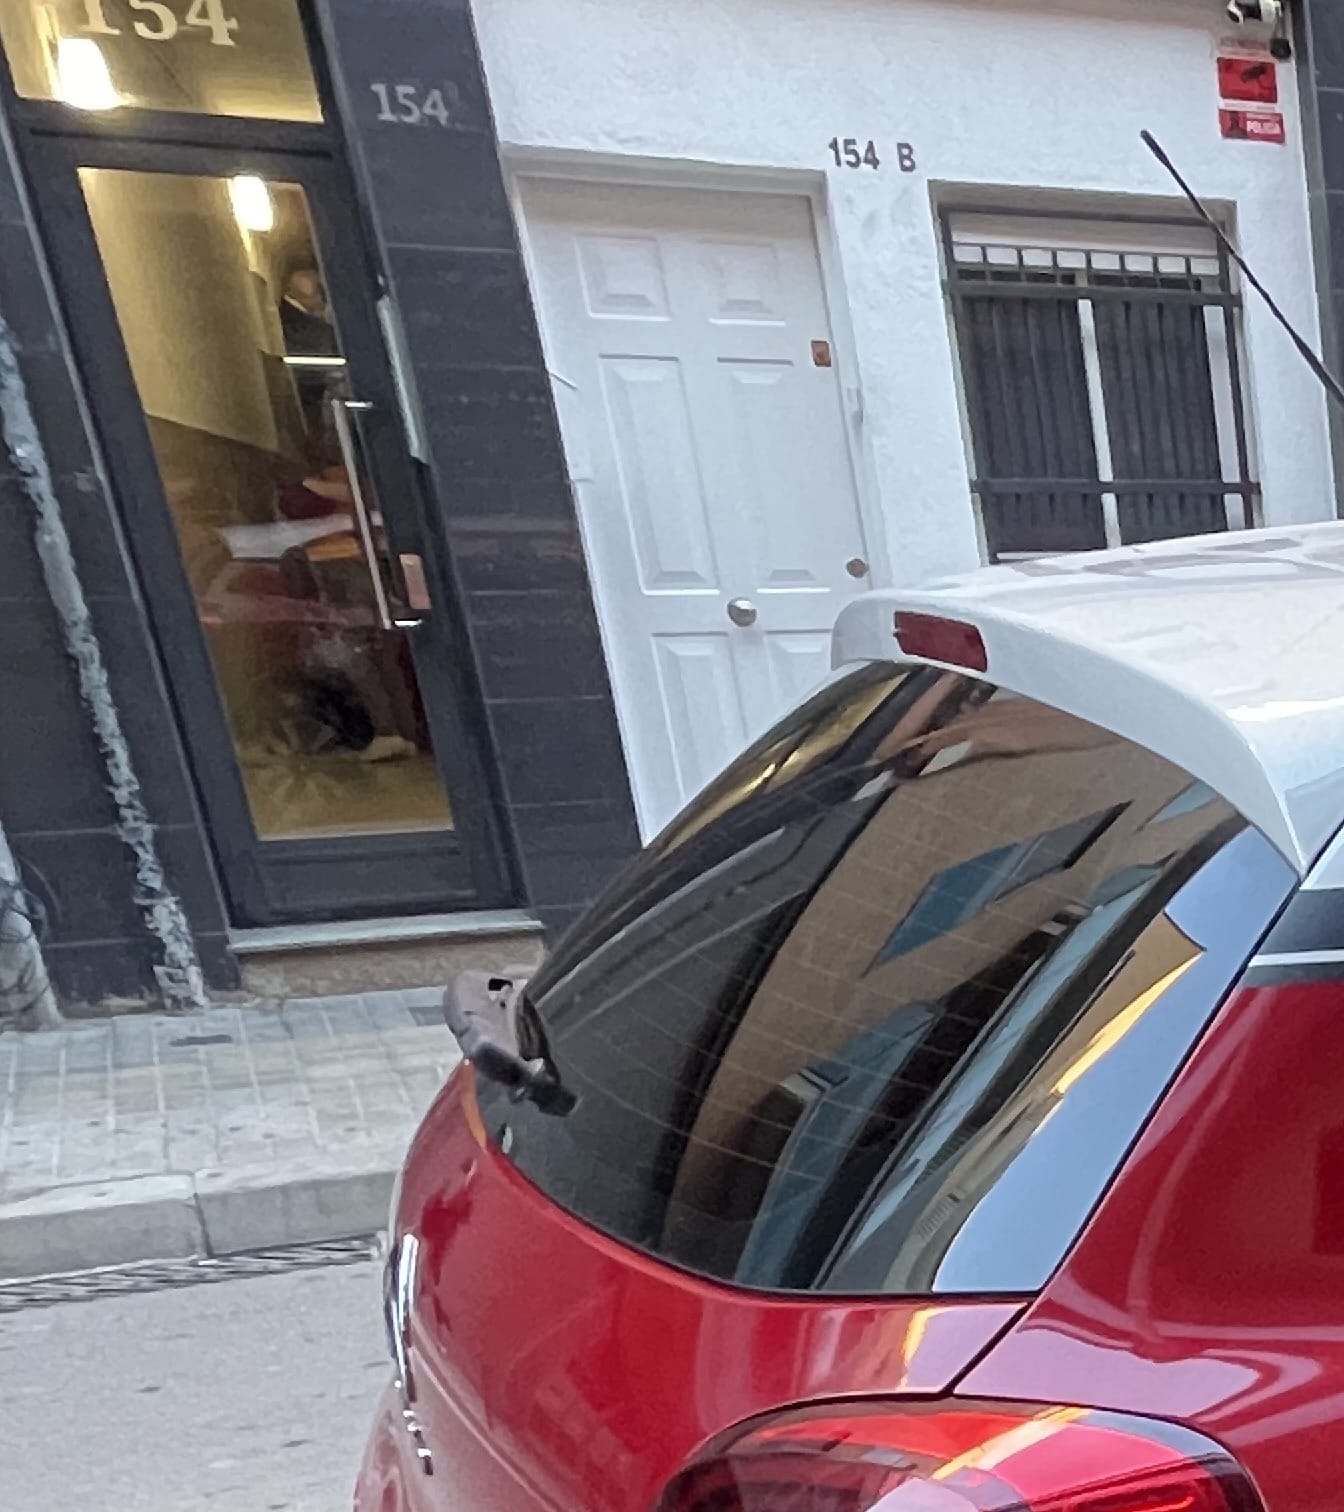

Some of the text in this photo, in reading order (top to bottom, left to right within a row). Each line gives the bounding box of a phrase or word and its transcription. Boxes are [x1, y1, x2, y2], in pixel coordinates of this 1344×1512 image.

[82, 0, 238, 46] 154
[370, 83, 449, 126] 154
[829, 137, 916, 172] 154 B
